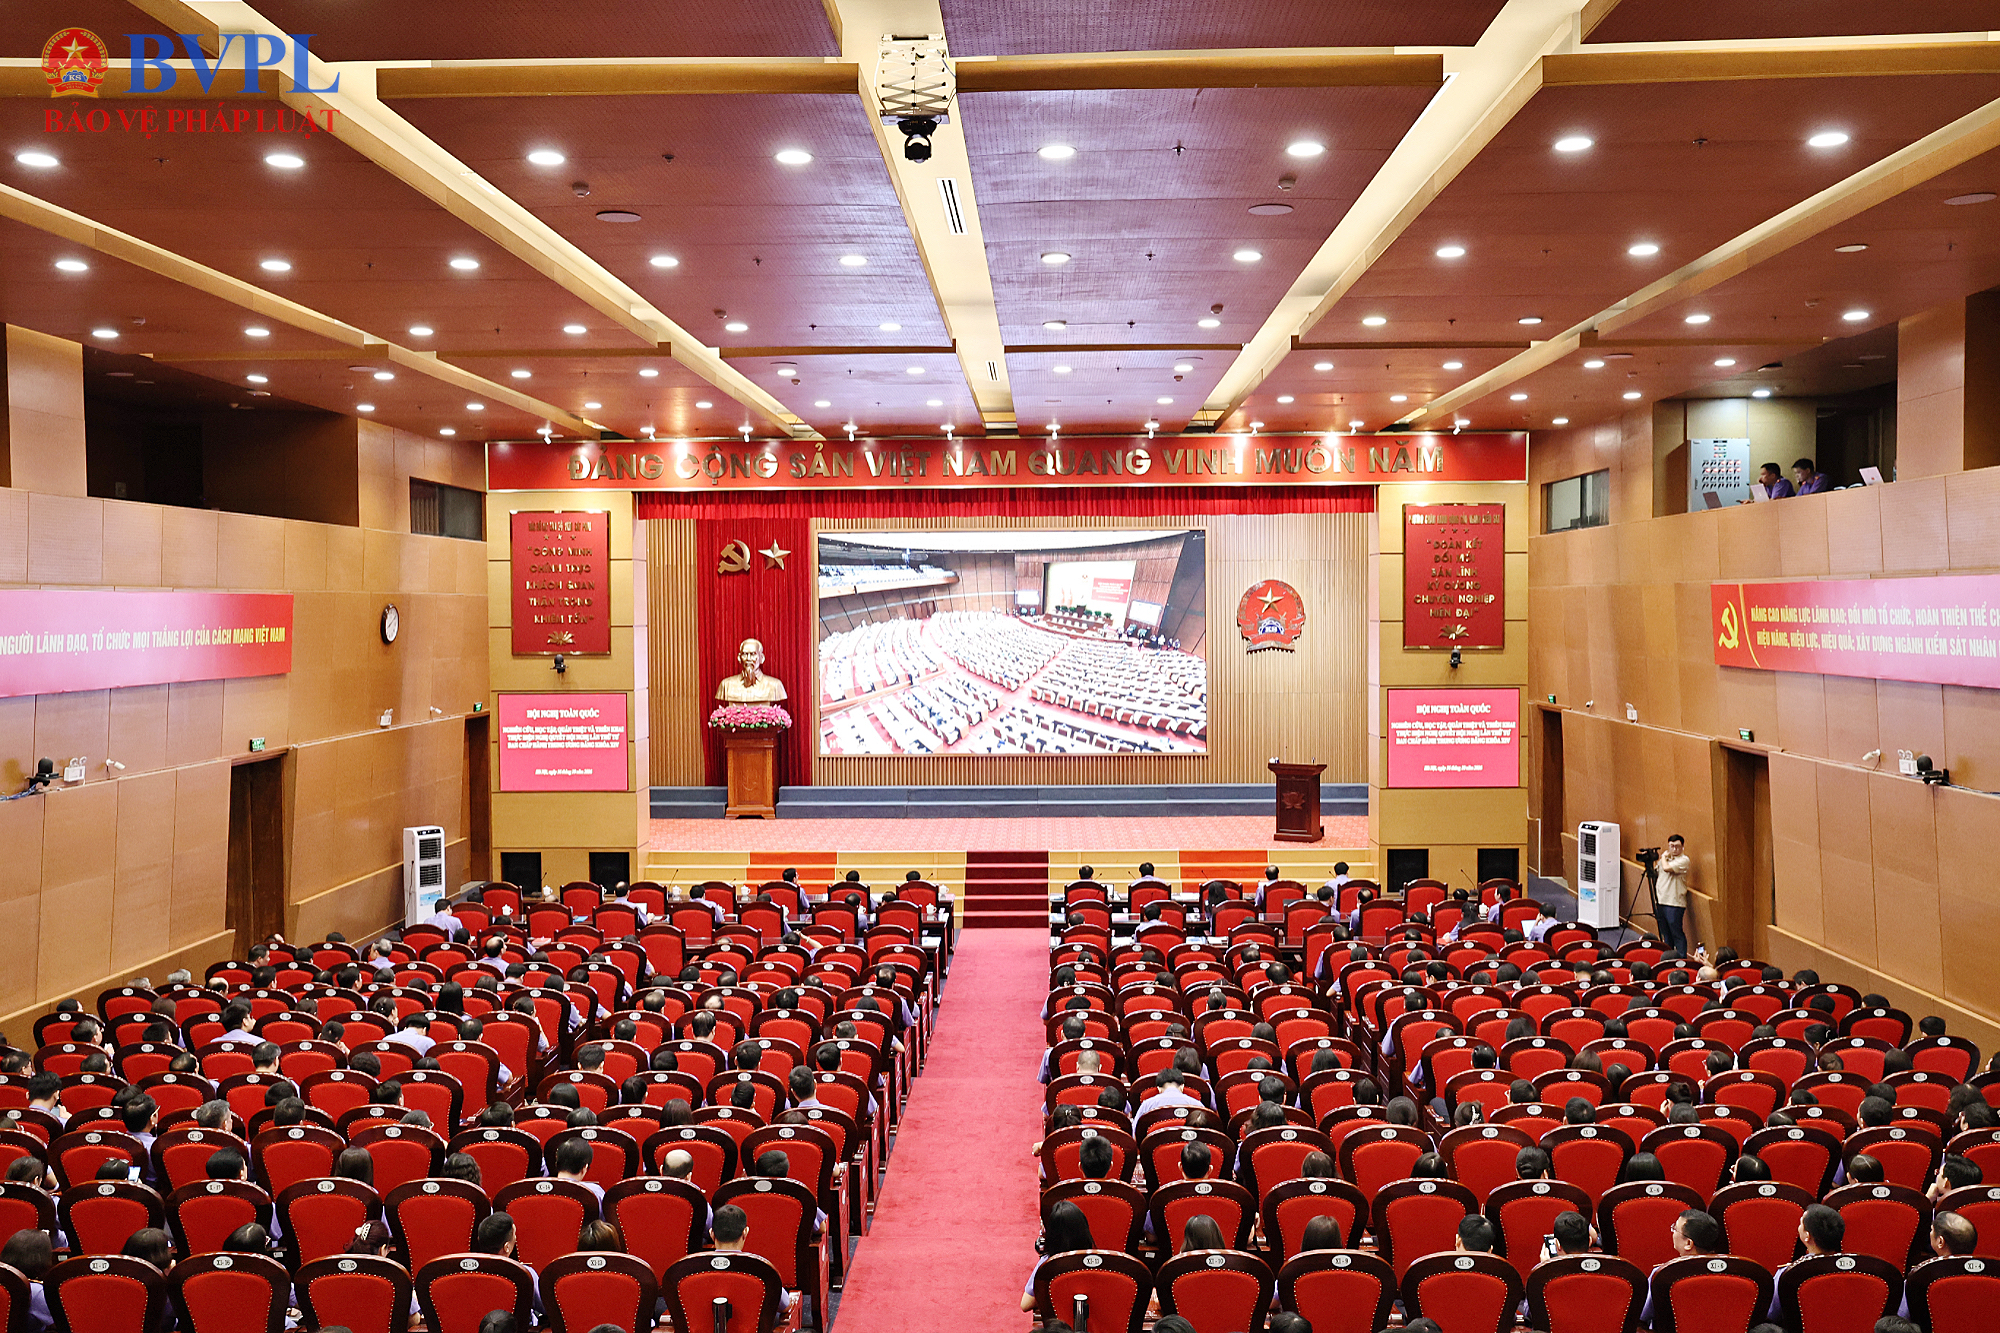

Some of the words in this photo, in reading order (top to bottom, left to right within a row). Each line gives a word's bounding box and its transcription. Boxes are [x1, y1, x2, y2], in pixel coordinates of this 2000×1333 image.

[567, 444, 664, 480] ĐẢNG
[674, 445, 778, 485] CỘNG
[789, 442, 854, 478] SẢN
[864, 443, 931, 483] VIỆT
[942, 450, 1017, 477] NAM
[1028, 448, 1152, 476] QUANG
[1163, 448, 1244, 475] VINH
[1255, 439, 1355, 474] MUÔN
[1369, 440, 1444, 473] NĂM
[1750, 604, 1767, 622] NÂNG
[1767, 607, 1780, 622] CAO
[1780, 605, 1798, 622] NĂNG
[1798, 606, 1811, 627] LỰC
[1811, 605, 1830, 624] LÃNH
[1848, 602, 1861, 625] ĐỔI
[1861, 605, 1877, 625] MỚI
[1877, 602, 1888, 625] TỔ
[1889, 605, 1914, 628] CHỨC,
[1915, 605, 1940, 626] HOÀN
[1940, 604, 1968, 630] THIỆN
[1968, 600, 1988, 627] THỂ
[0, 630, 34, 655] NGƯỜI
[36, 631, 64, 653] LÃNH
[66, 634, 89, 656] ĐẠO,
[91, 626, 105, 651] TỔ
[106, 629, 131, 650] CHỨC
[132, 631, 150, 652] MỌI
[152, 624, 179, 648] THẮNG
[180, 628, 194, 650] LỢI
[194, 624, 210, 646] CỦA
[212, 625, 232, 646] CÁCH
[232, 628, 254, 647] MẠNG
[255, 624, 269, 646] VIỆT
[270, 627, 286, 643] NAM
[1757, 628, 1771, 649] HIỆU
[1771, 629, 1790, 649] NĂNG,
[1790, 629, 1805, 651] HIỆU
[1805, 632, 1820, 651] LỰC,
[1821, 631, 1837, 653] HIỆU
[1856, 632, 1870, 651] XÂY
[1872, 635, 1894, 656] DỰNG
[1894, 633, 1924, 654] NGÀNH
[1925, 630, 1948, 655] KIỂM
[1949, 634, 1967, 656] SÁT
[1968, 635, 1997, 658] NHÂN
[526, 708, 540, 720] HỘI
[541, 709, 559, 720] NGHỊ
[559, 707, 579, 718] TOÀN
[579, 707, 600, 719] QUỐC
[1416, 704, 1430, 715] HỘI
[1431, 705, 1449, 715] NGHỊ
[1450, 703, 1469, 714] TOÀN
[1470, 703, 1491, 715] QUỐC
